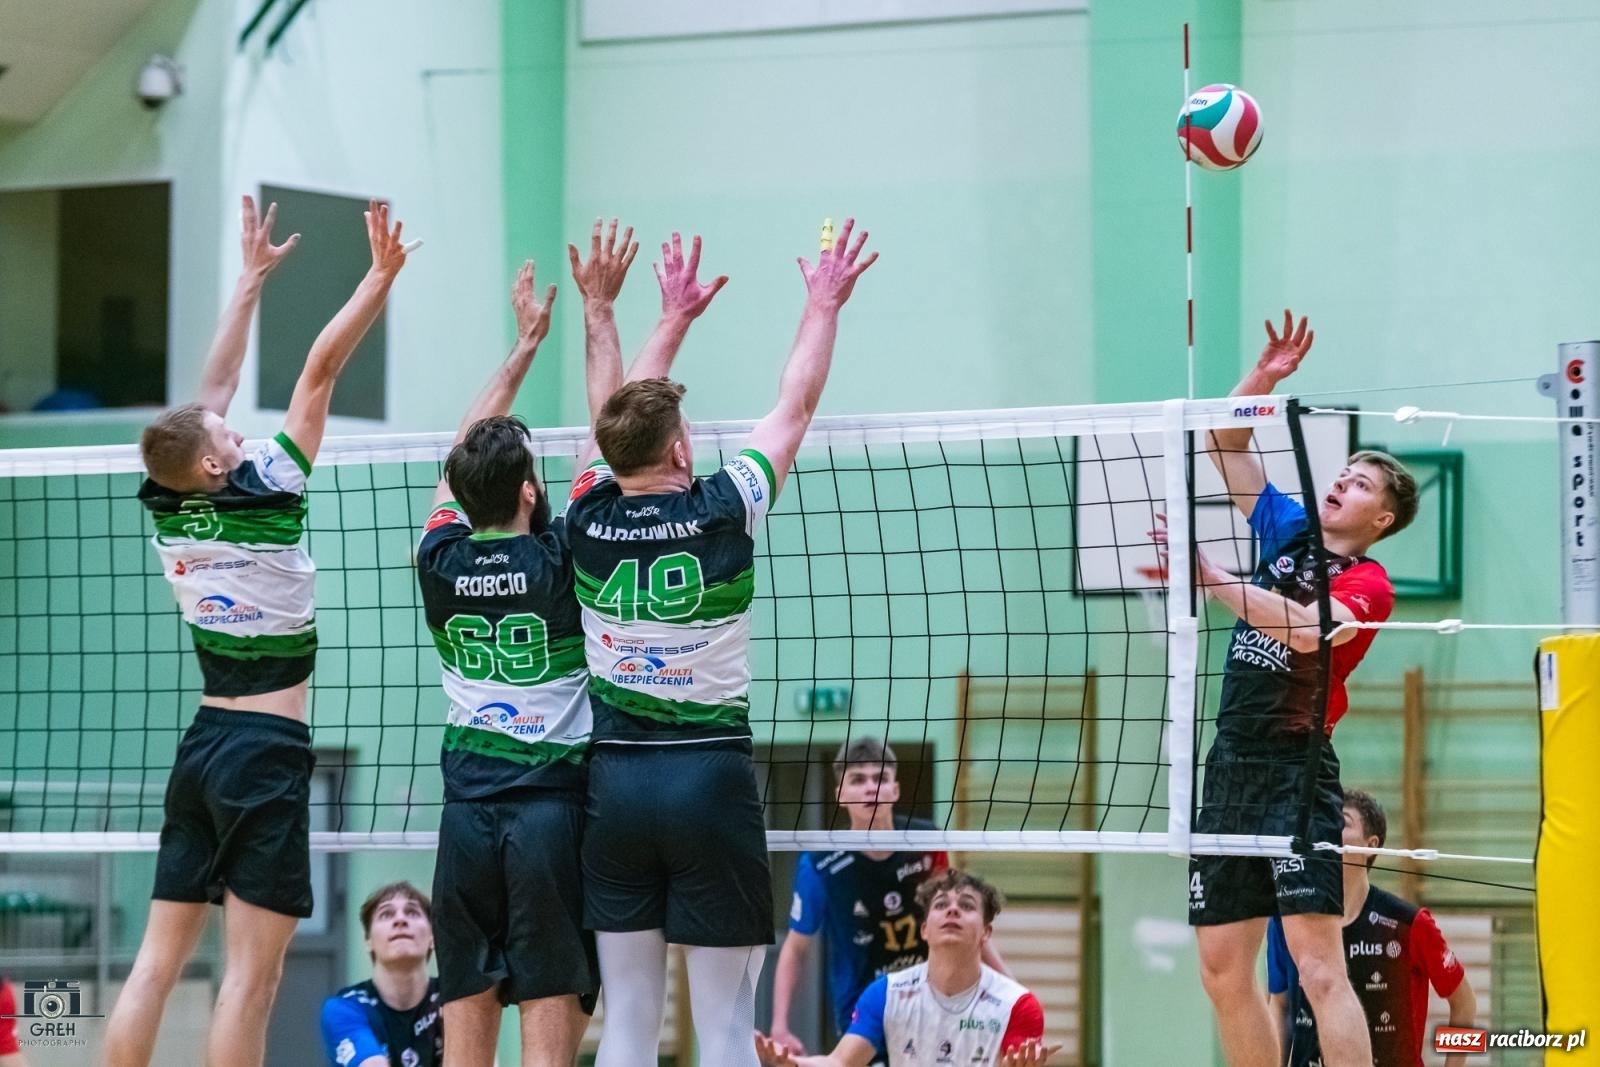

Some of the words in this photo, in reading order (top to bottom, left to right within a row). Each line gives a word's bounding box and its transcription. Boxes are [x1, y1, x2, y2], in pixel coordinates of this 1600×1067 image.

[1233, 404, 1276, 418] netex
[586, 519, 703, 541] MARCHWIAK
[455, 571, 528, 597] ROBCIO
[594, 551, 705, 622] 49
[196, 611, 263, 625] BEZPECZENIA
[445, 613, 550, 684] 69
[1234, 629, 1292, 666] NOWAK
[612, 674, 694, 686] UBEZPIECZENIA
[658, 668, 694, 677] MULTI
[512, 715, 545, 725] MULTI
[896, 860, 923, 882] plus
[879, 914, 918, 951] 17
[1349, 940, 1383, 959] plus
[959, 1018, 985, 1031] plus
